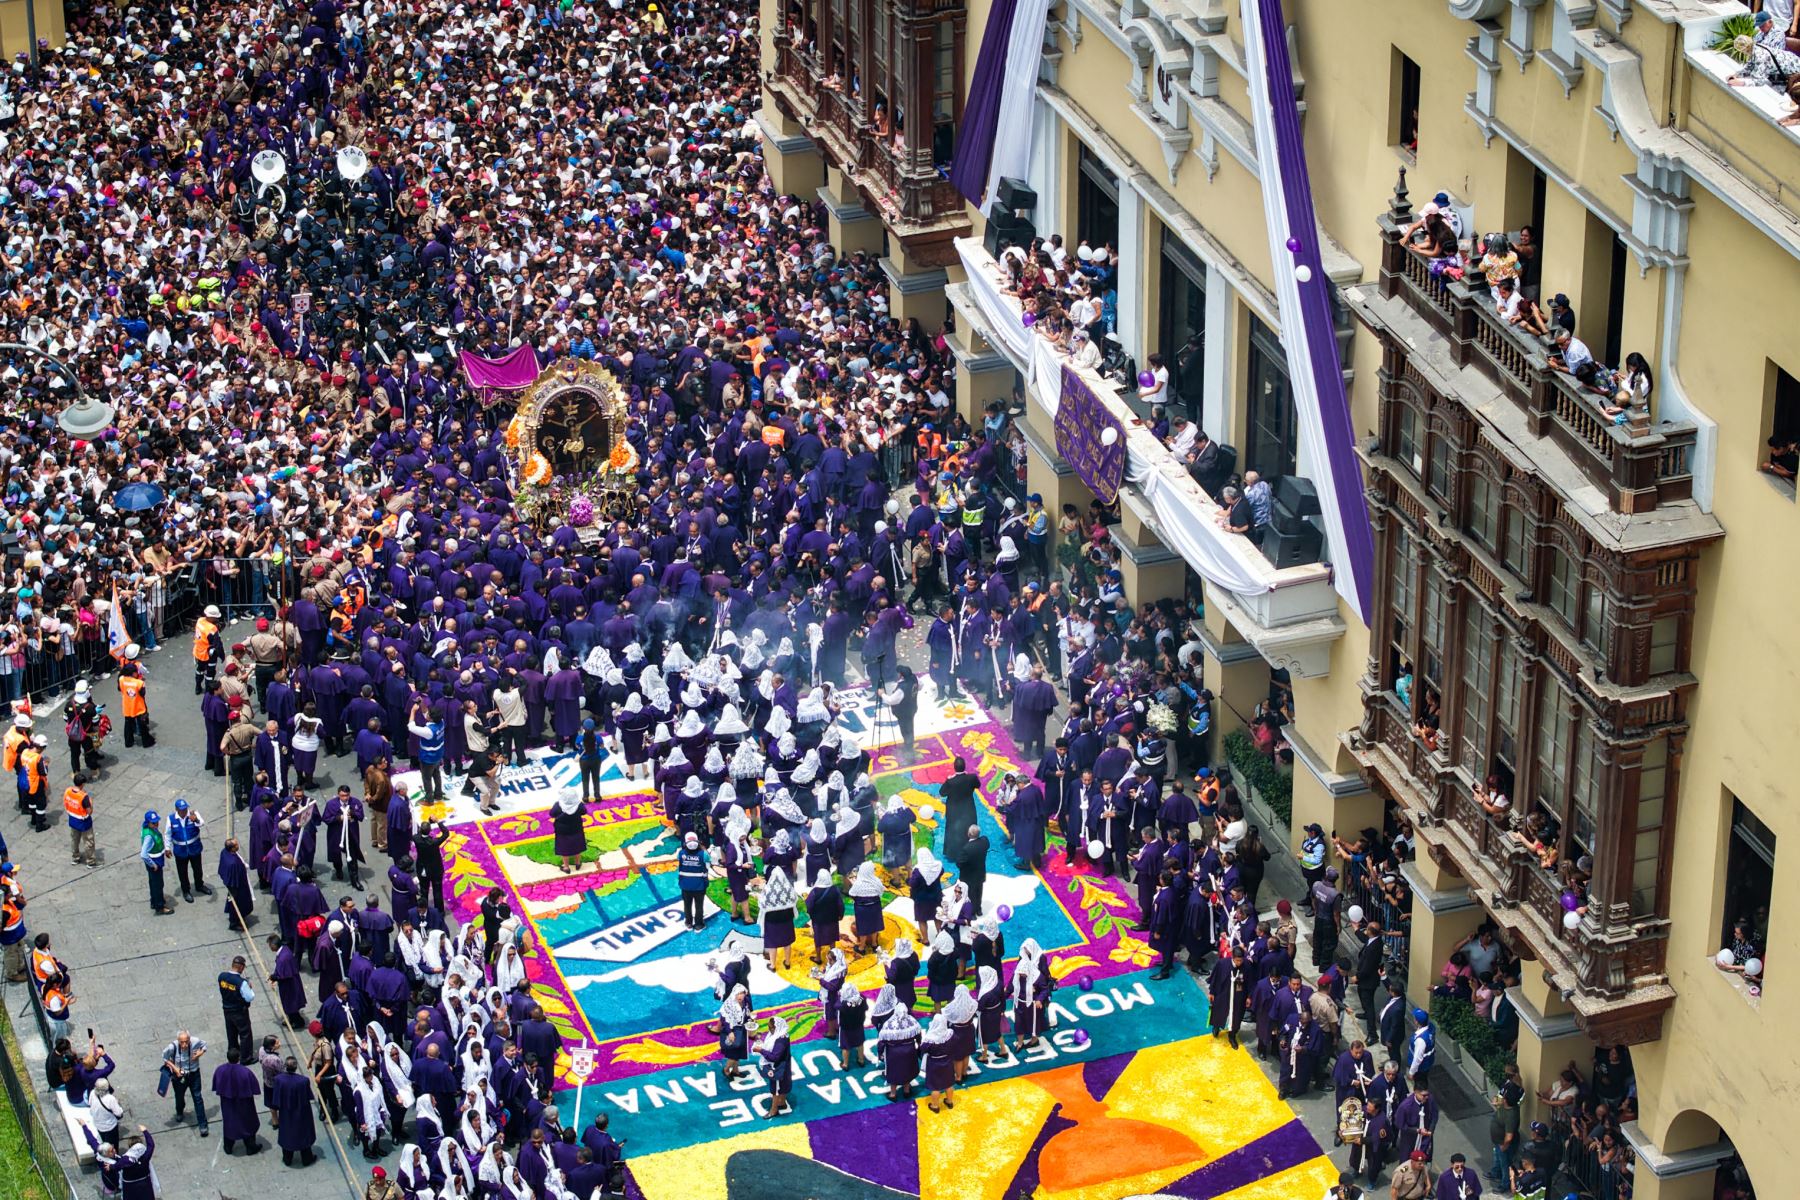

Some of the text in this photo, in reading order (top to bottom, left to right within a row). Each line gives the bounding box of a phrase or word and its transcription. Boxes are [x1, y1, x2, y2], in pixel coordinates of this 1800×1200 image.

[254, 153, 279, 165] FAP
[342, 148, 363, 158] FAP
[590, 909, 685, 950] GMML
